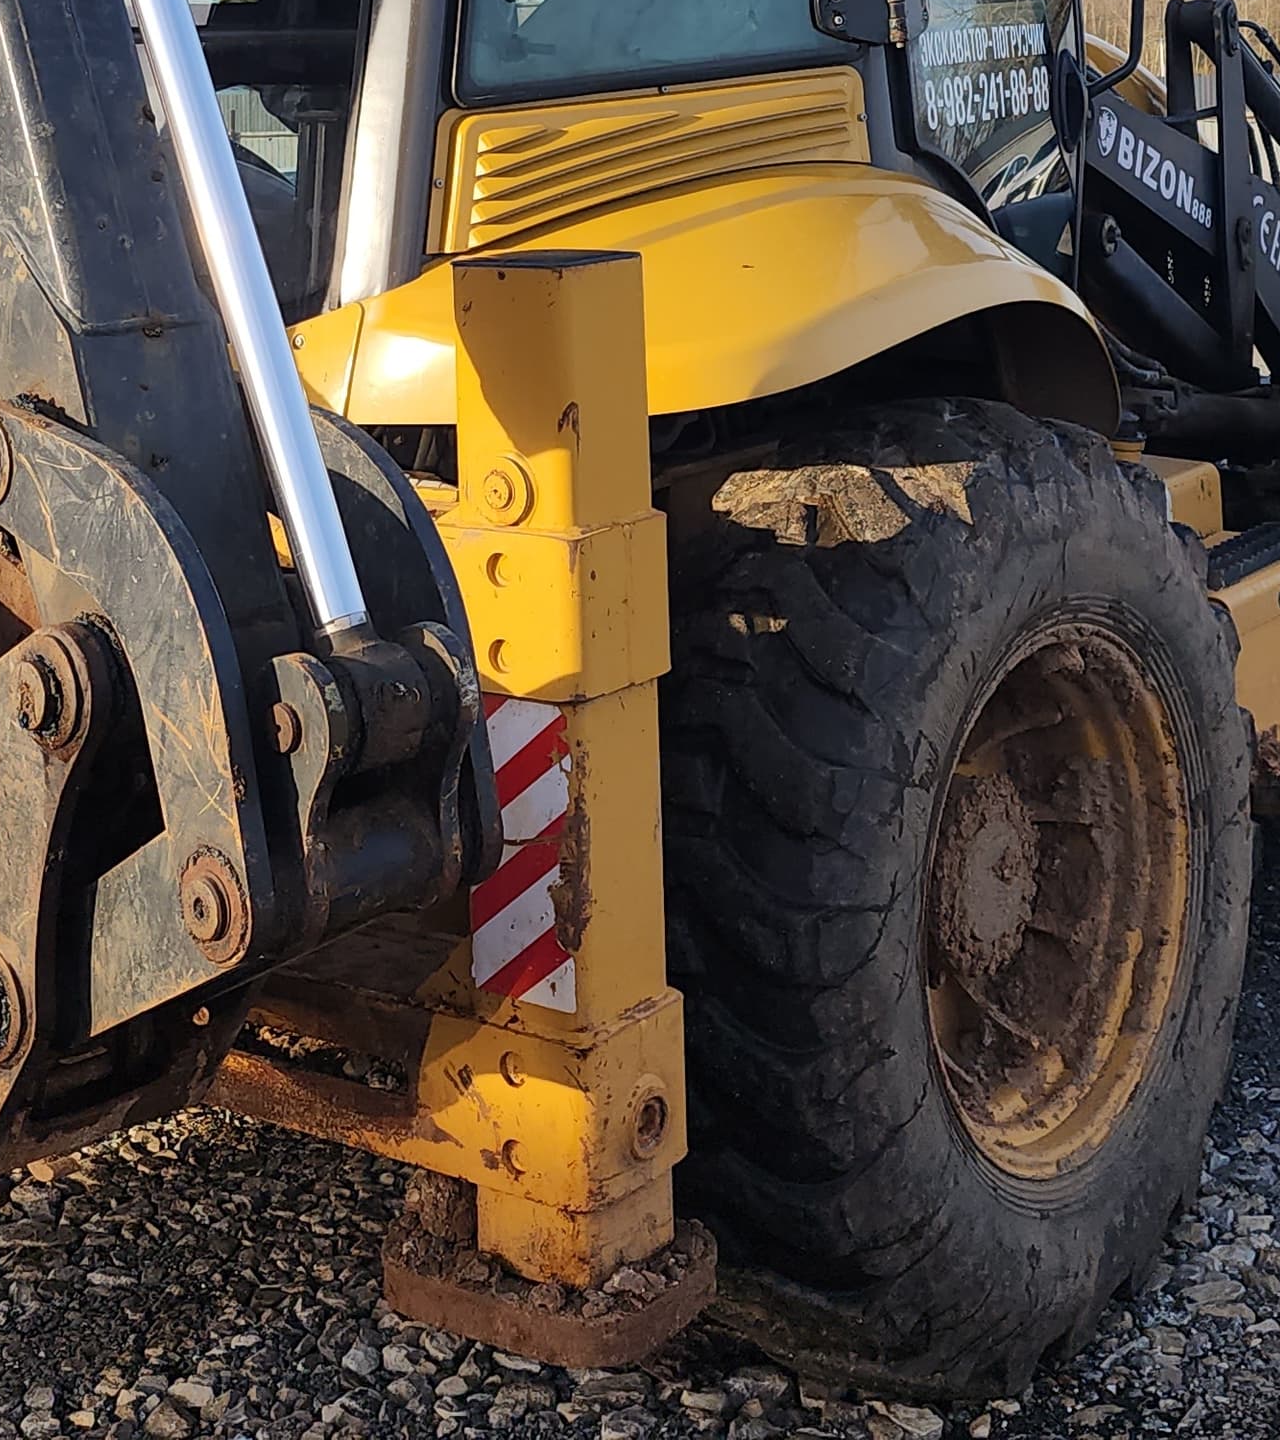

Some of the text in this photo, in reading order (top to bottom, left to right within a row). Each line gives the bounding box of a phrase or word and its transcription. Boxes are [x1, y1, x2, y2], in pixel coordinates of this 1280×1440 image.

[920, 23, 1047, 67] ЭКСКАВАТОР-ПОГРУЗЧИК
[925, 66, 1050, 130] 8-982-241-88-88
[1117, 126, 1213, 229] BIZON 888
